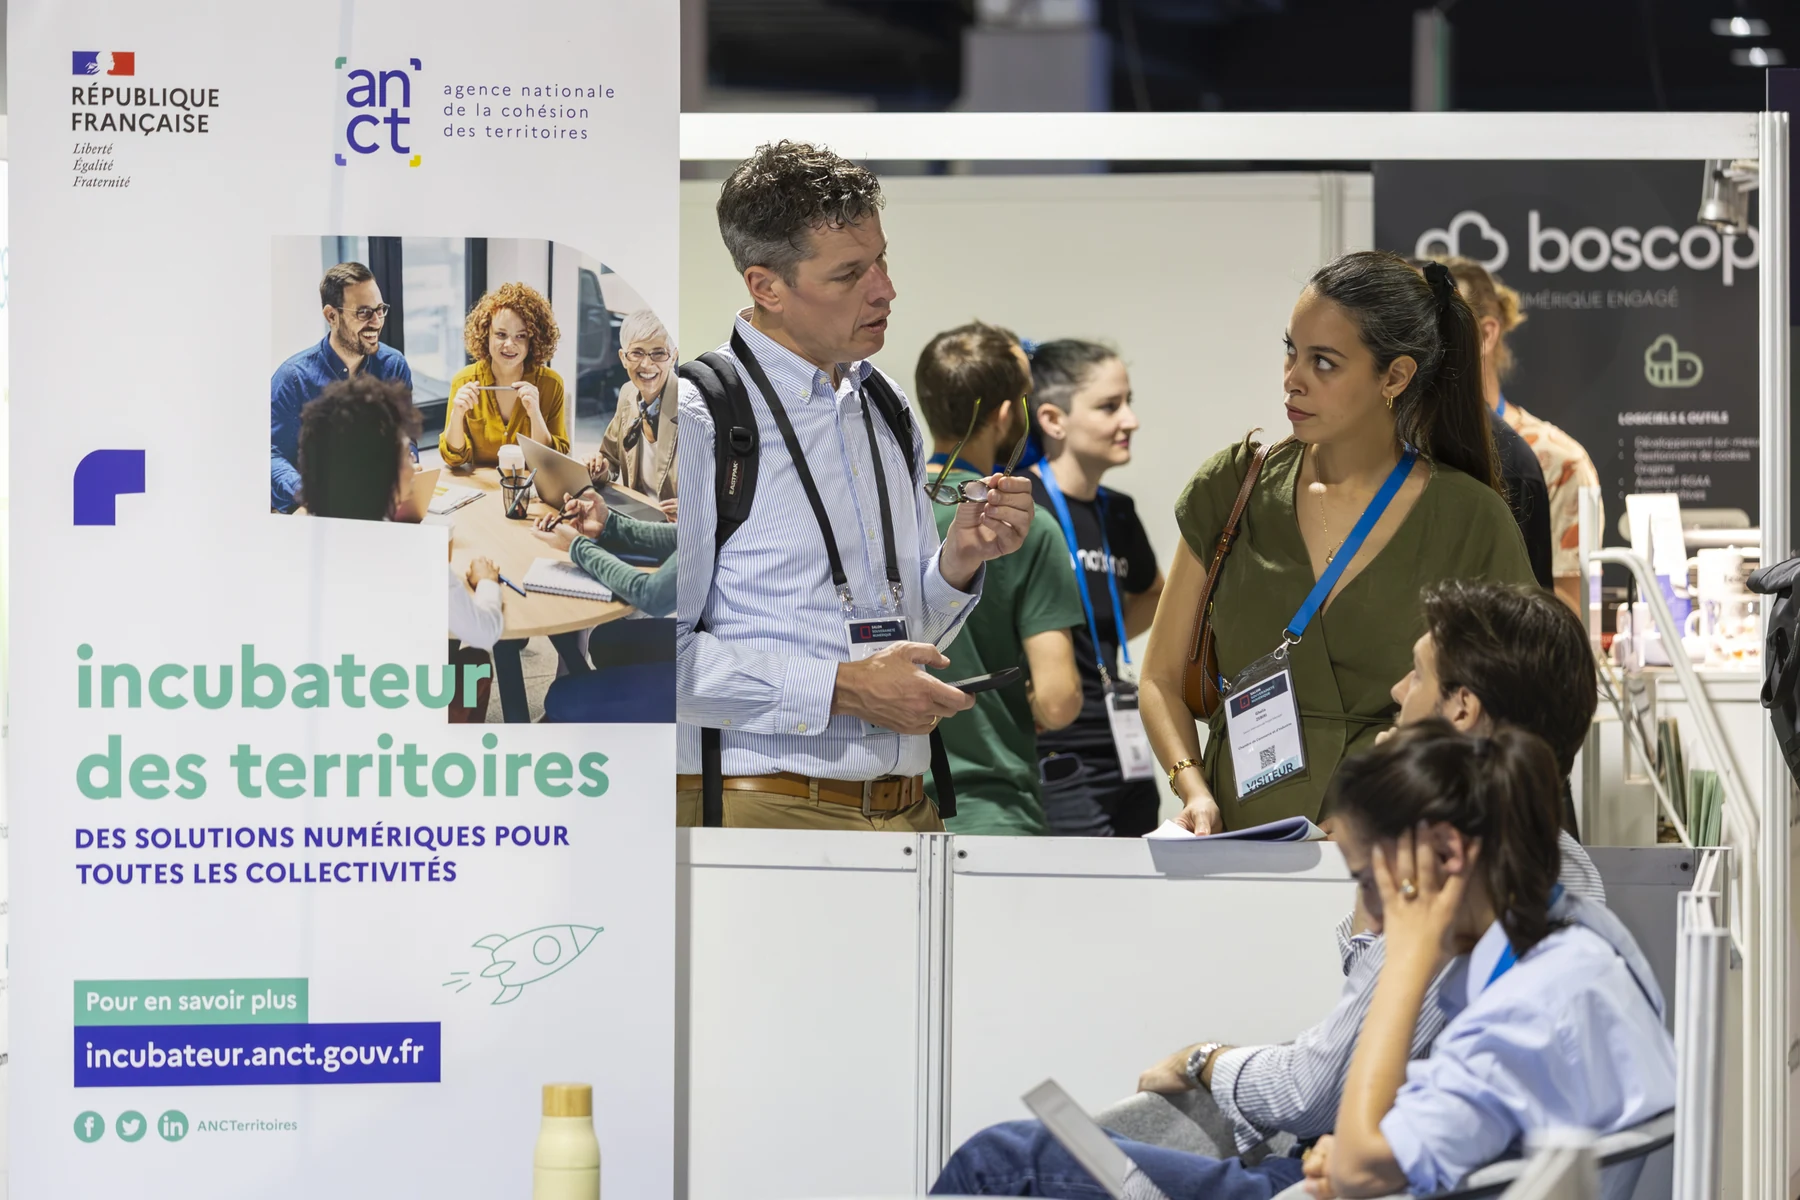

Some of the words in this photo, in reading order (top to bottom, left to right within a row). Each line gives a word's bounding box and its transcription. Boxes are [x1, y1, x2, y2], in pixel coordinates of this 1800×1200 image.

[72, 83, 220, 111] RÉPUBLIQUE
[443, 84, 512, 99] agence
[521, 84, 615, 99] nationale
[443, 102, 466, 117] de
[475, 102, 491, 117] la
[501, 103, 589, 119] cohésion
[72, 112, 209, 137] FRANÇAISE
[443, 123, 476, 138] des
[485, 124, 588, 140] territoires
[72, 142, 113, 155] Liberté
[73, 157, 114, 173] Égalité
[72, 175, 131, 188] Fraternité
[1528, 210, 1758, 286] boscop
[1519, 287, 1602, 309] MÉRIQUE
[1607, 285, 1679, 308] ENGAGÉ
[729, 462, 738, 495] EASTPAK
[77, 643, 491, 709] incubateur
[76, 735, 207, 800] des
[230, 733, 610, 799] territoires
[1246, 762, 1293, 788] VISITEUR
[75, 828, 127, 850] DES
[135, 826, 294, 849] SOLUTIONS
[304, 821, 486, 851] NUMÉRIQUES
[495, 825, 570, 847] POUR
[76, 863, 184, 885] TOUTES
[193, 862, 238, 884] LES
[245, 856, 457, 884] COLLECTIVITÉS
[86, 991, 138, 1012] Pour
[144, 995, 172, 1012] en
[178, 989, 244, 1012] savoir
[251, 988, 297, 1016] plus
[86, 1038, 424, 1073] incubateur.anct.gouv.fr
[197, 1118, 298, 1132] ANCTerritoires
